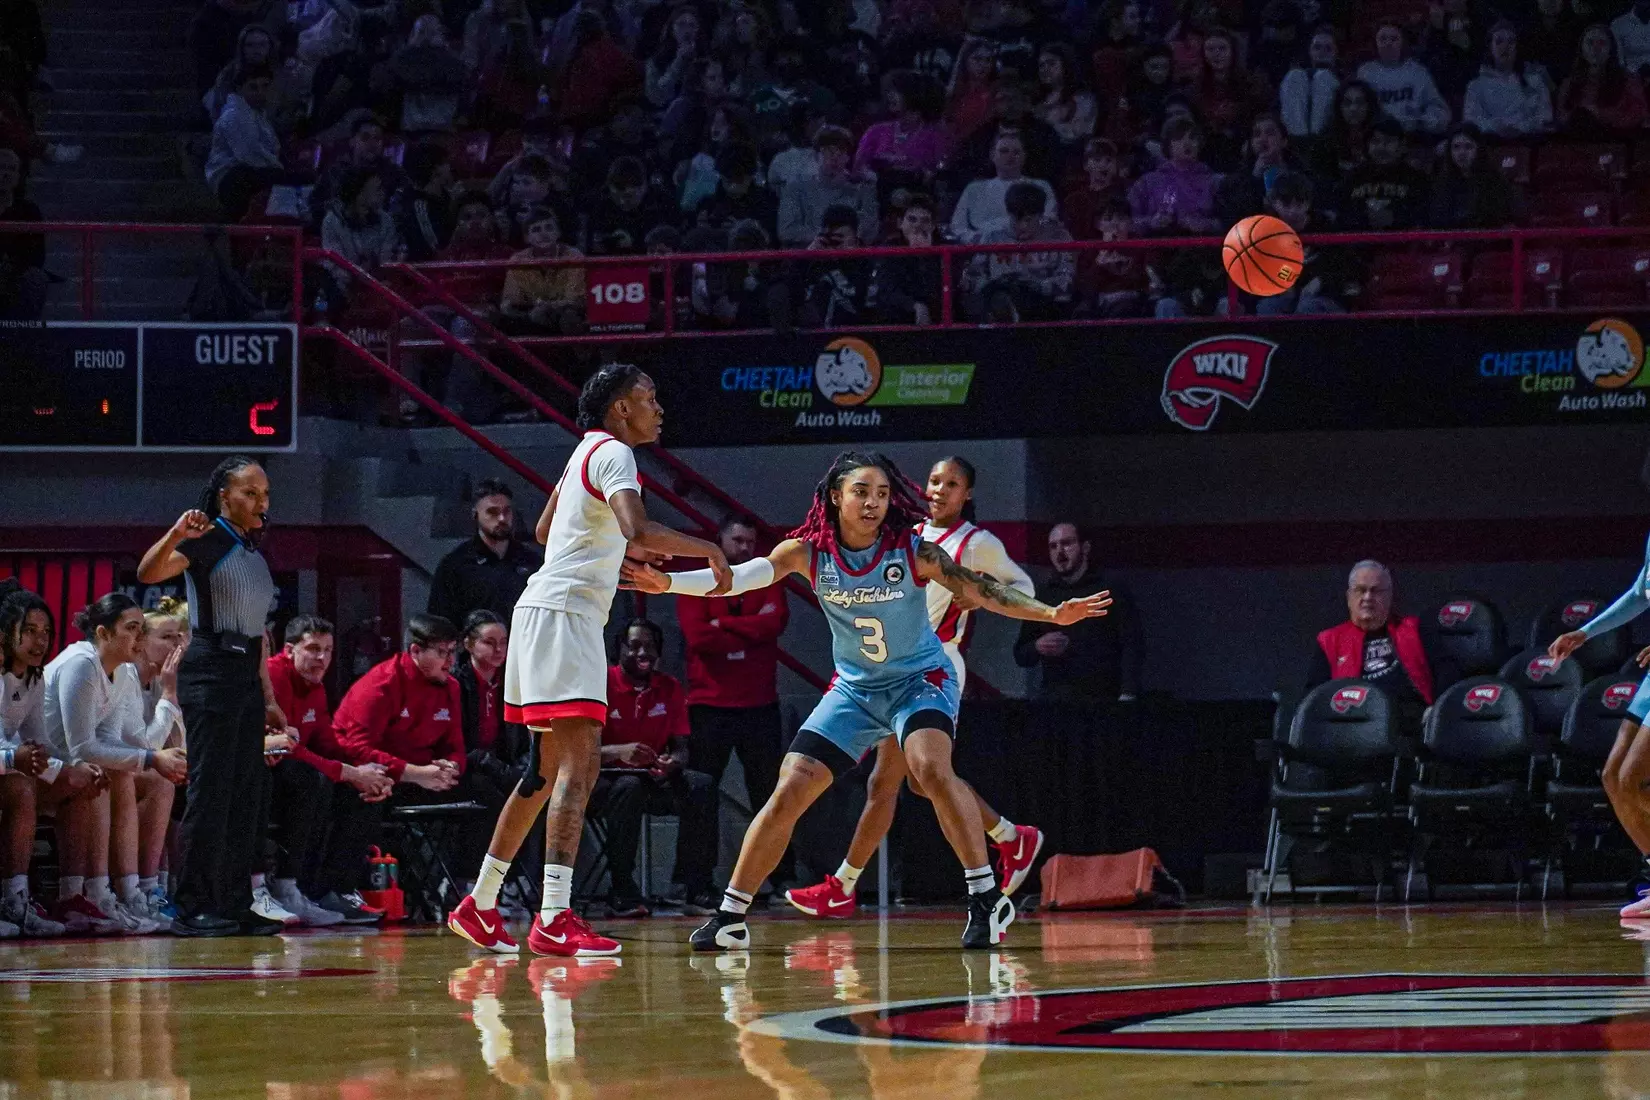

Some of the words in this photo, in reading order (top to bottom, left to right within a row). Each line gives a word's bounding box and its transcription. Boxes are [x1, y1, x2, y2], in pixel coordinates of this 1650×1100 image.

[590, 282, 645, 304] 108
[75, 350, 125, 368] PERIOD
[195, 334, 279, 364] GUEST
[1192, 352, 1249, 379] WKU
[1479, 350, 1575, 377] CHEETAH
[720, 366, 814, 391] CHEETAH
[900, 369, 968, 386] Interior
[1521, 374, 1576, 393] Clean
[760, 389, 813, 408] Clean
[1559, 394, 1599, 411] Auto
[1601, 391, 1646, 408] Wash
[795, 411, 834, 427] Auto
[837, 409, 881, 427] Wash
[824, 588, 852, 609] Lady
[853, 616, 889, 664] 3
